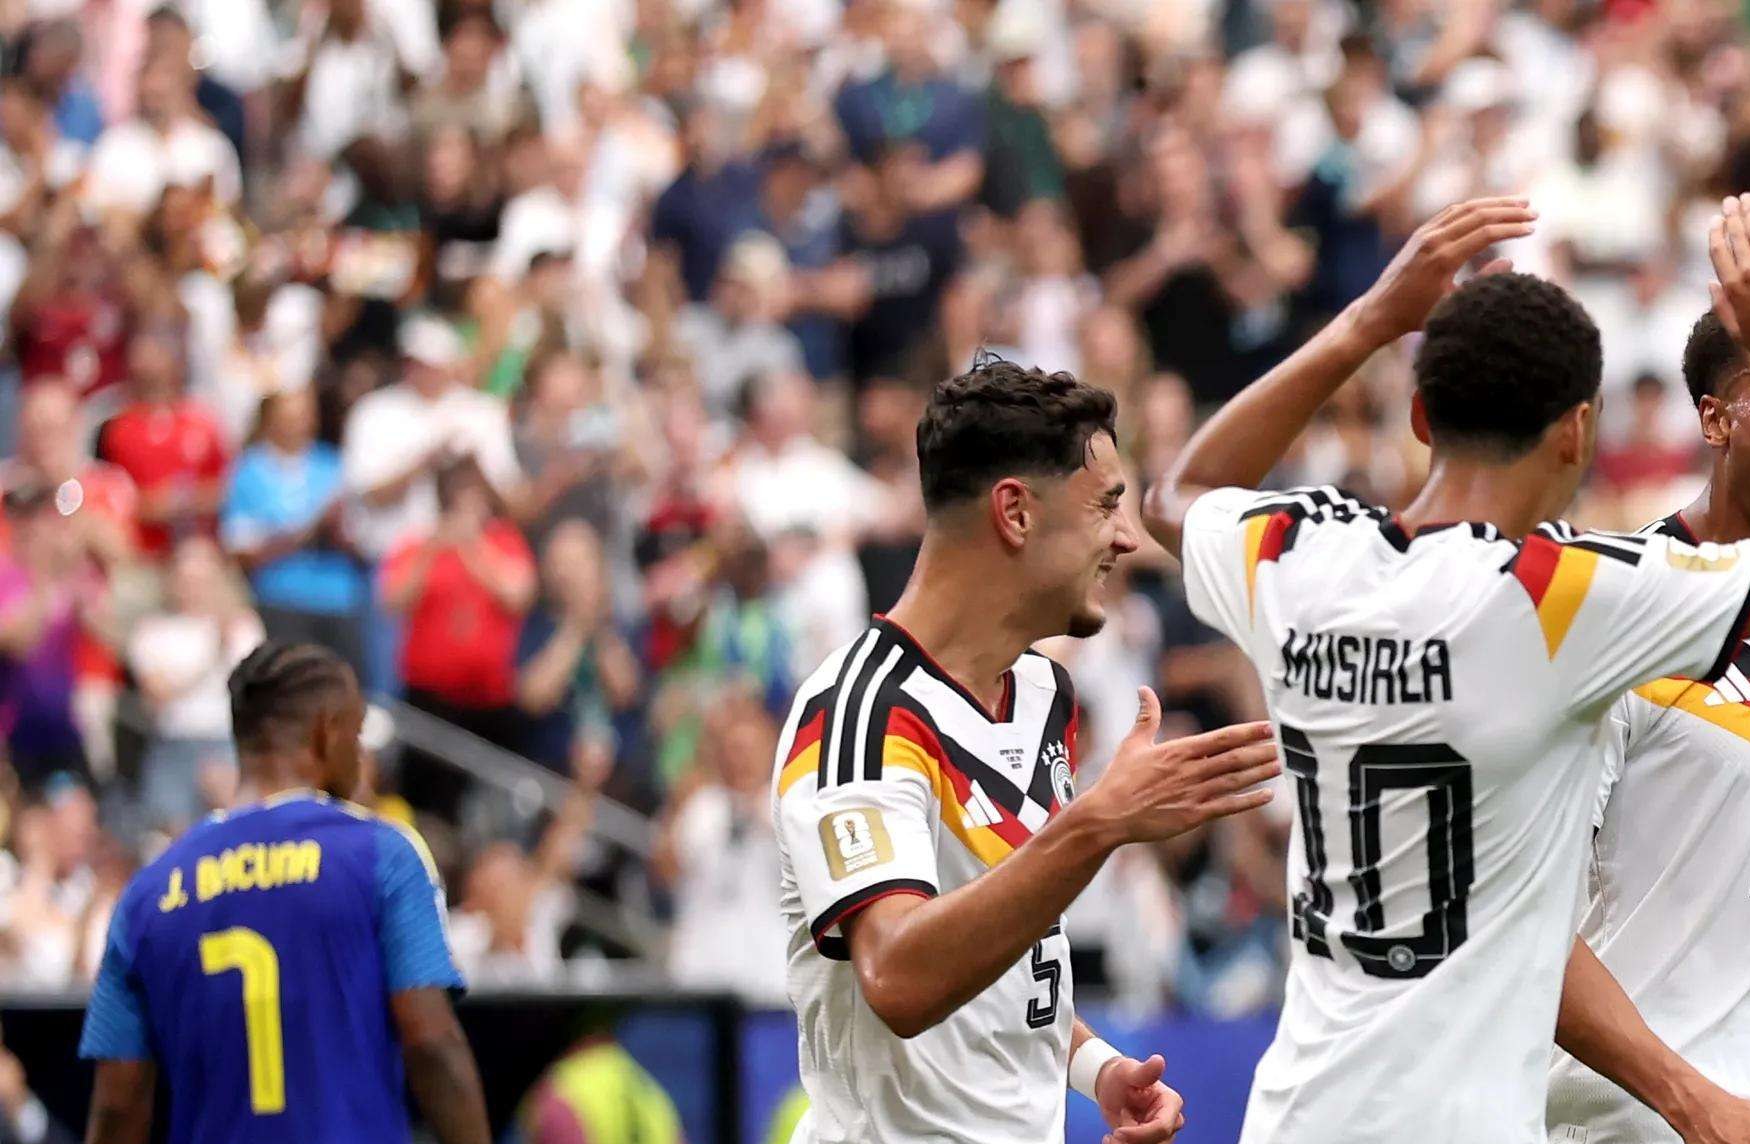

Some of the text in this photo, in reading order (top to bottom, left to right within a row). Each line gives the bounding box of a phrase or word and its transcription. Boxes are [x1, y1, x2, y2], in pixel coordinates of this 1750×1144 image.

[1281, 628, 1453, 704] MUSIALA
[158, 839, 321, 912] J. BACUNA
[1280, 723, 1475, 979] 10
[199, 926, 286, 1116] 7
[1026, 914, 1063, 1029] 5
